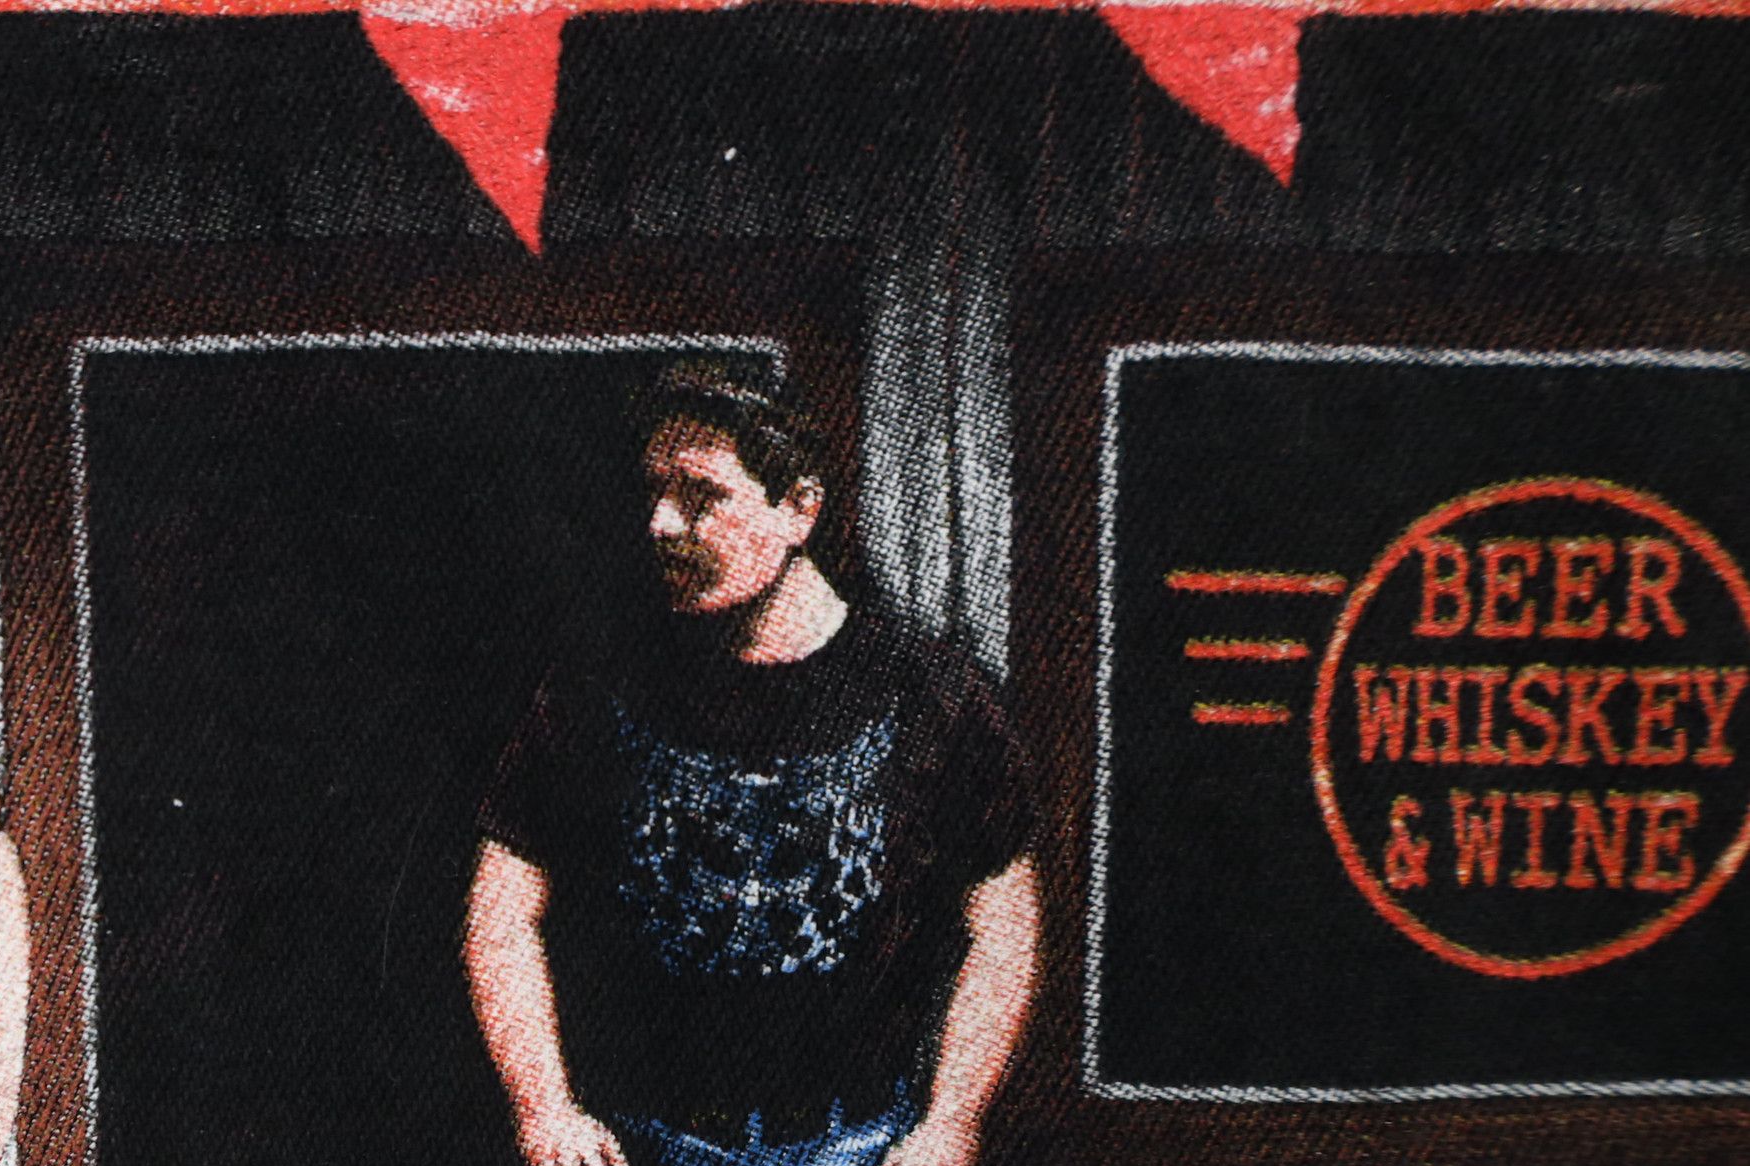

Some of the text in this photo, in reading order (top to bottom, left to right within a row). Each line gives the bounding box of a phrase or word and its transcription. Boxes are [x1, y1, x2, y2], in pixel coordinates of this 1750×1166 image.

[1412, 536, 1687, 639] BEER
[1353, 664, 1749, 766] WHISKEY
[1383, 790, 1700, 891] & WINE
